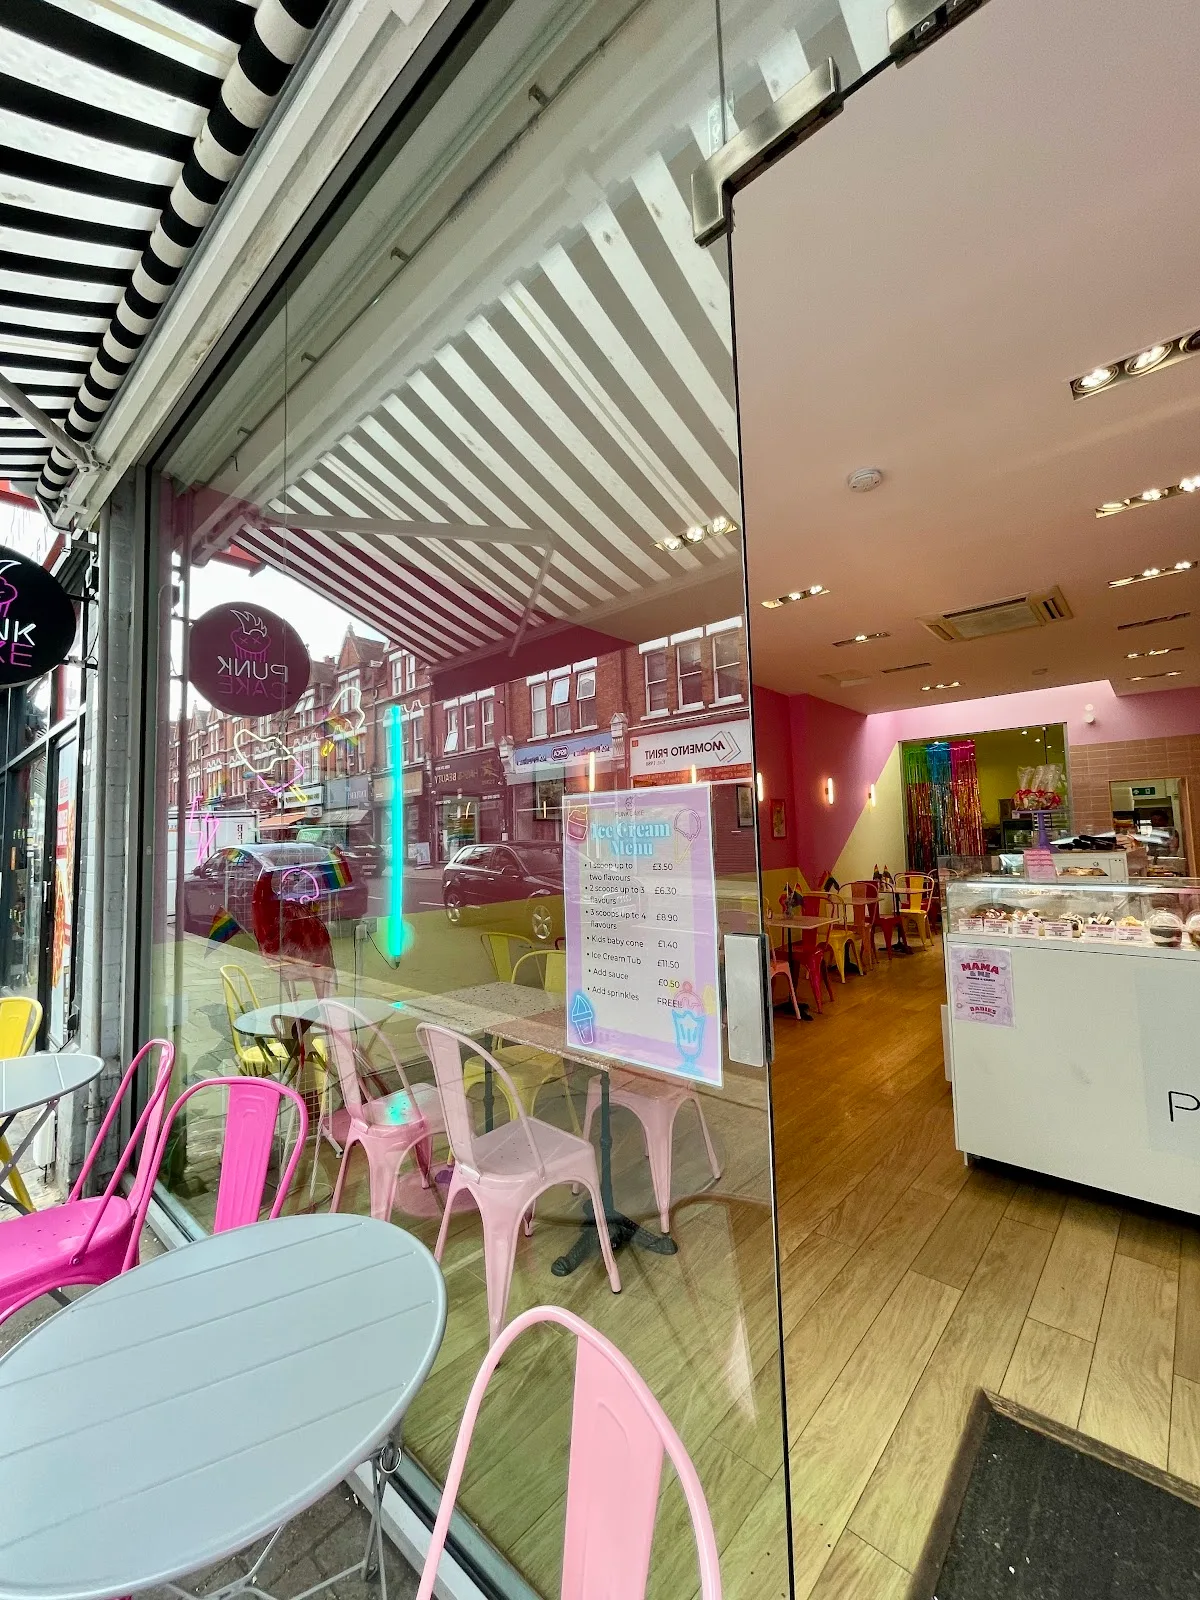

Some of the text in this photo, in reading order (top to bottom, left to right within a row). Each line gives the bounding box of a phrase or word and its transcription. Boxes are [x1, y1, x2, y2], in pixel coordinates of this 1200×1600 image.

[591, 821, 671, 839] Ice Cream
[611, 840, 653, 856] Menu
[652, 862, 674, 871] £3.50
[589, 873, 631, 882] two flavours
[594, 885, 618, 893] scoops
[654, 886, 677, 895] £6.30
[590, 896, 617, 904] flavours
[595, 910, 619, 918] scoops
[620, 912, 630, 920] up
[656, 913, 679, 922] £8.90
[590, 920, 617, 930] flavours
[591, 935, 644, 948] Kids baby cone
[657, 940, 678, 949] £1.40
[591, 951, 642, 965] Ice Cream Tub
[657, 959, 680, 969] £11.50
[961, 962, 1000, 975] MAMA
[593, 968, 629, 980] Add sauce
[658, 978, 680, 989] £0.50
[592, 986, 640, 1001] Add sprinkles
[969, 1006, 997, 1015] BABIES
